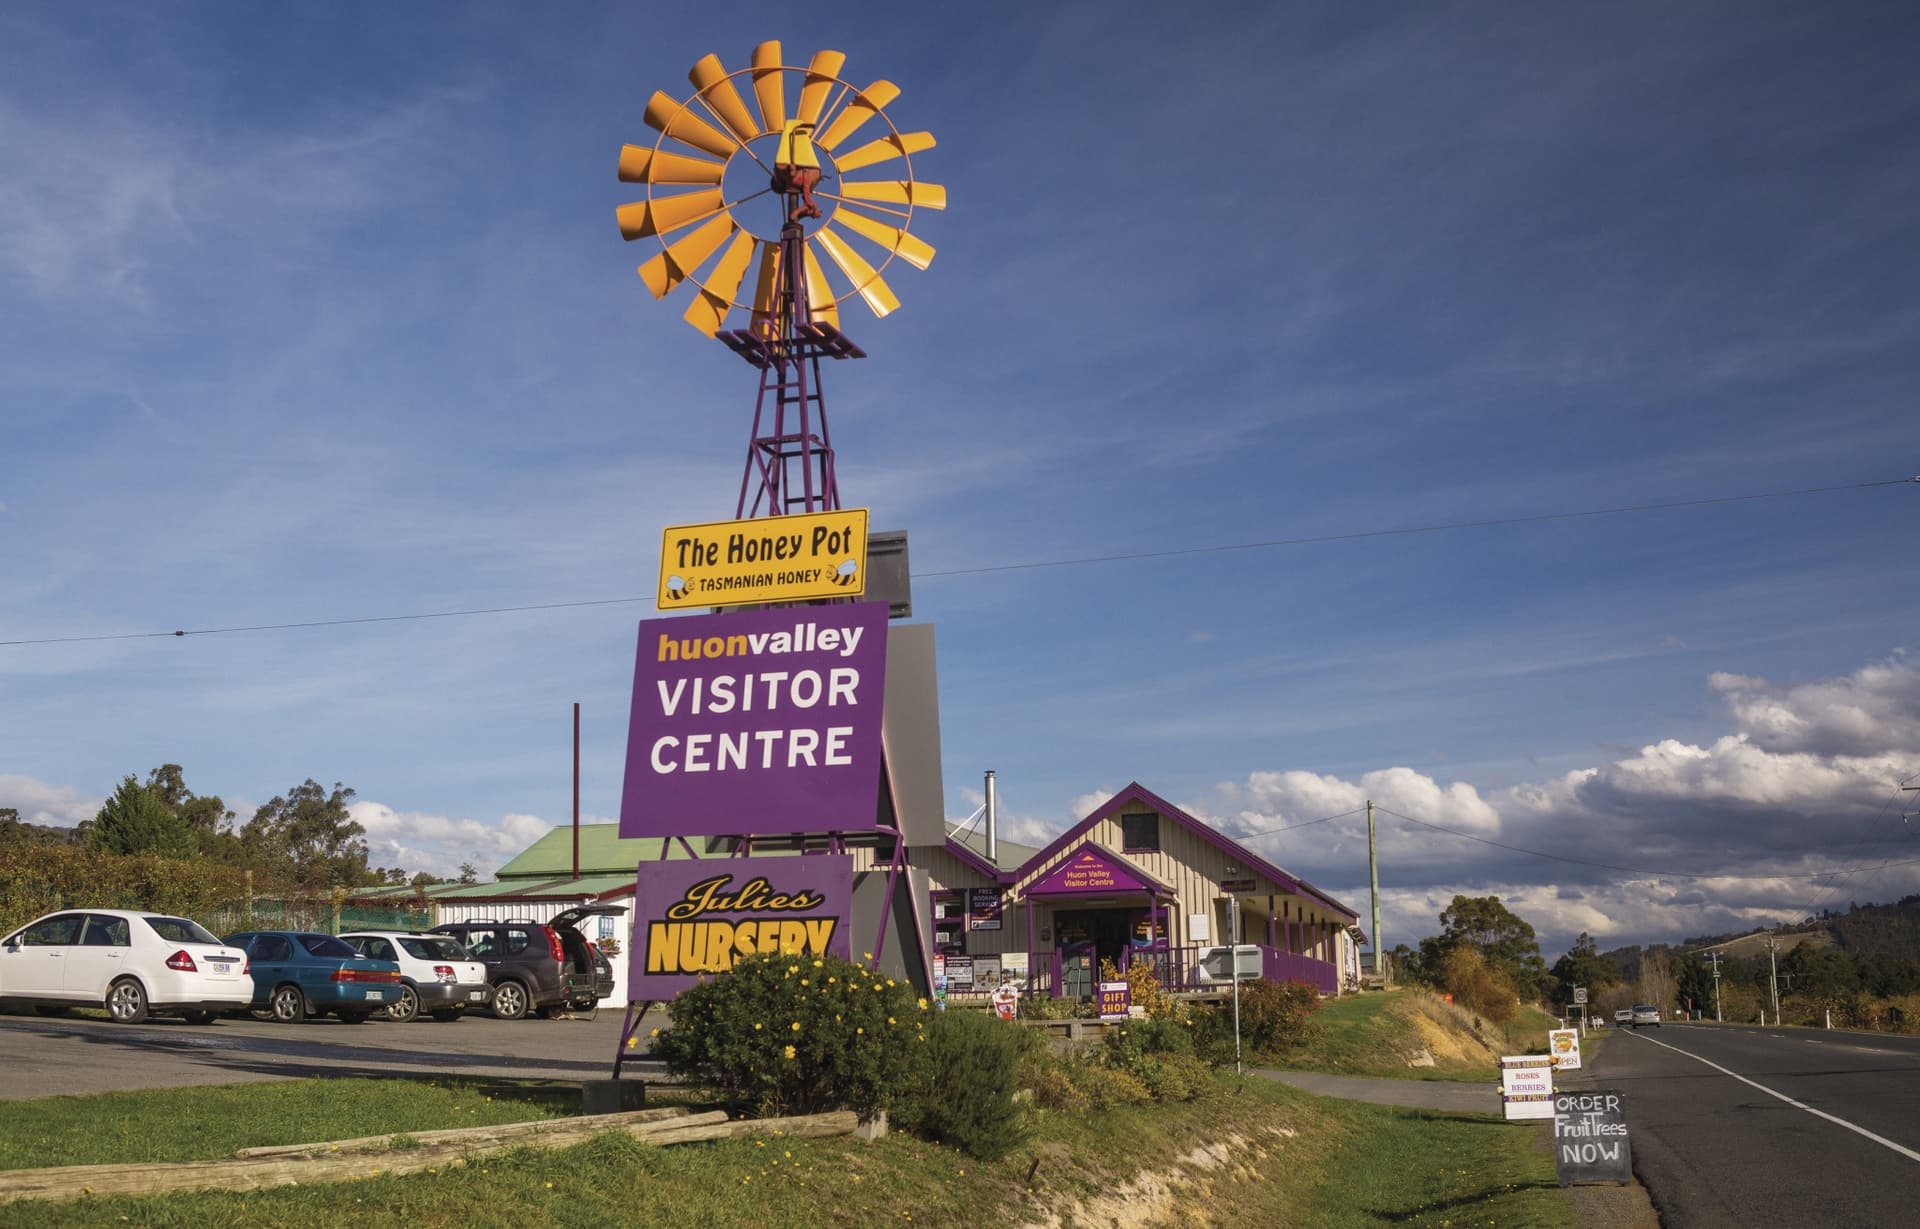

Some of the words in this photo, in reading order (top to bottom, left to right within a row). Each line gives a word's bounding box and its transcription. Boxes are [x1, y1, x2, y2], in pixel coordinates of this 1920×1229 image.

[677, 538, 719, 568] The
[728, 533, 803, 564] Honey
[811, 526, 851, 556] Pot
[700, 574, 773, 592] TASMANIAN
[777, 569, 821, 585] HONEY
[657, 622, 865, 662] huonvalley
[657, 667, 860, 716] VISITOR
[650, 726, 854, 775] CENTRE
[1064, 879, 1088, 888] Visitor
[1089, 879, 1115, 887] Centre
[1067, 871, 1087, 879] Huon
[1088, 870, 1111, 879] Valley
[667, 874, 824, 920] Julies
[646, 918, 837, 974] NURSERY
[1103, 992, 1125, 1002] GIFT
[1101, 1003, 1127, 1014] SHOP
[1515, 1072, 1540, 1080] ROSES
[1511, 1083, 1546, 1091] BERRIES
[1556, 1095, 1620, 1112] ORDER
[1562, 1142, 1620, 1163] NOW
